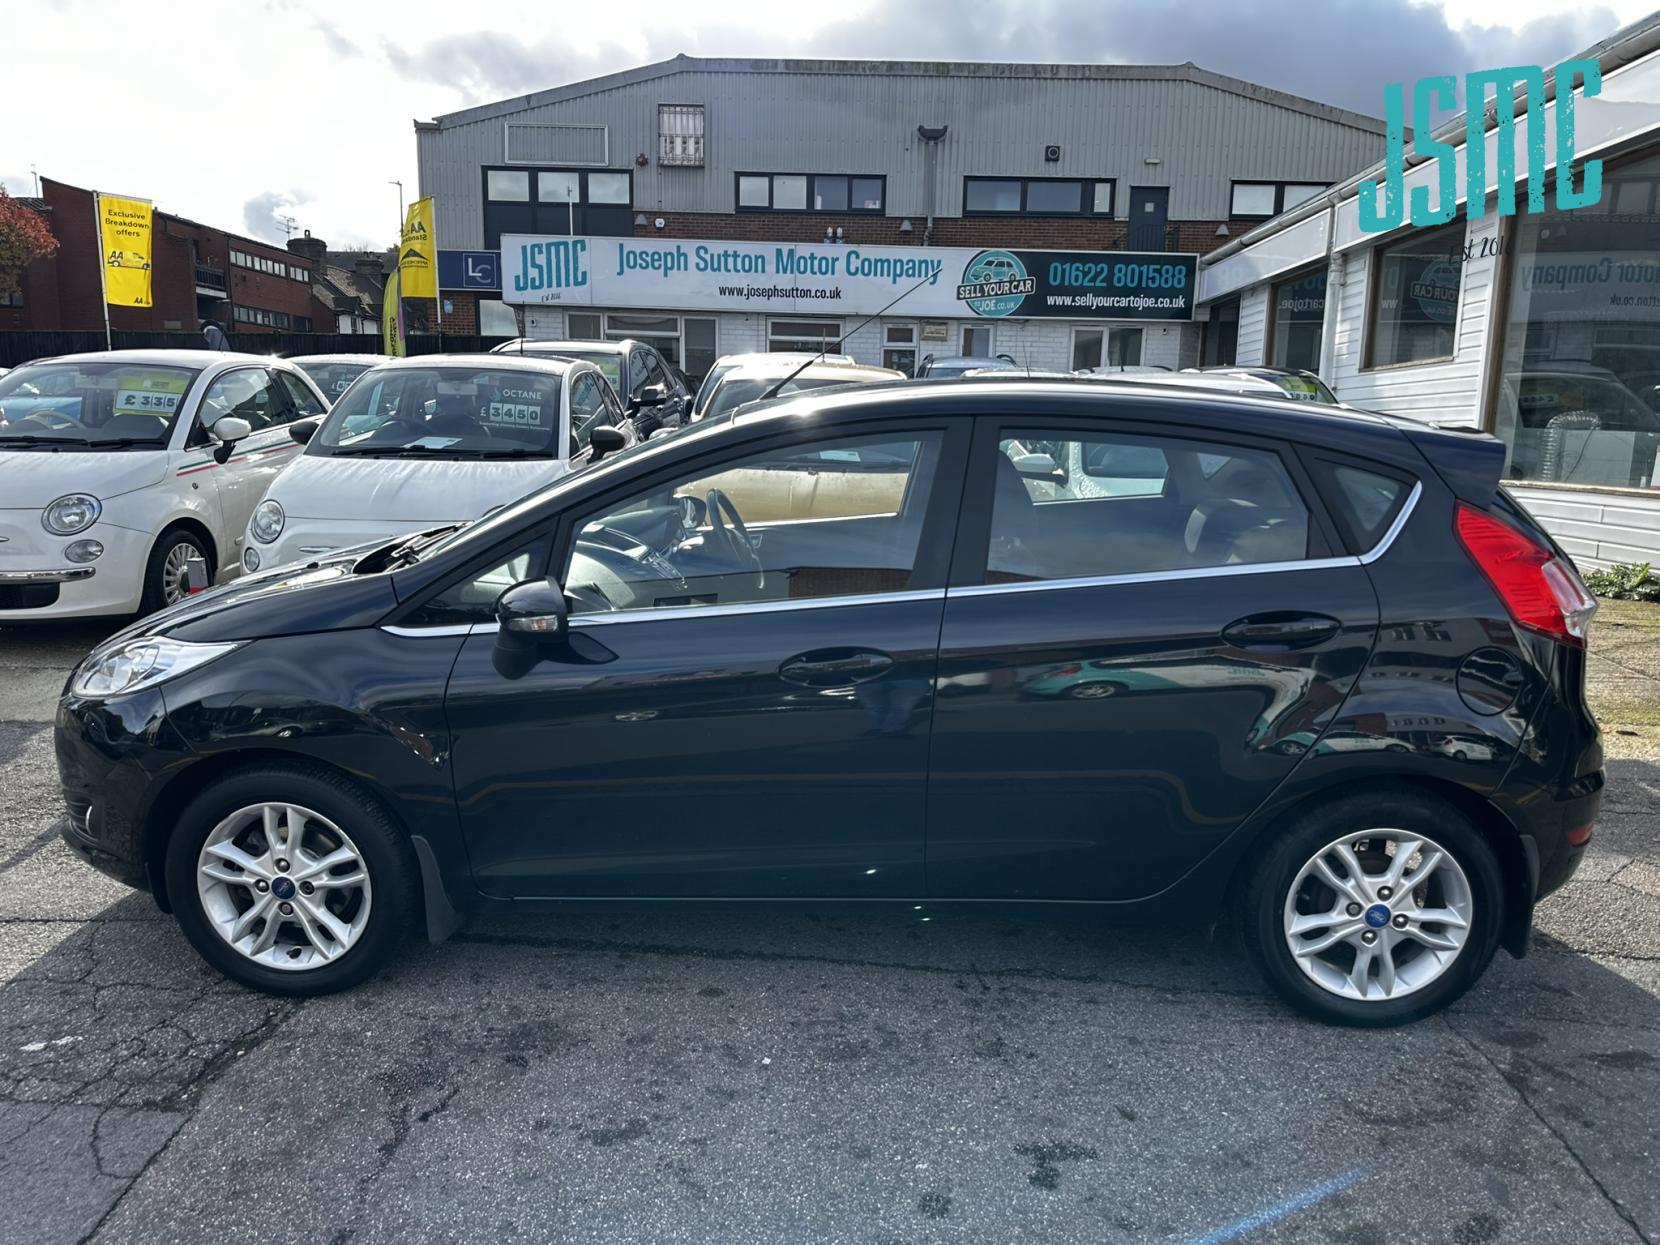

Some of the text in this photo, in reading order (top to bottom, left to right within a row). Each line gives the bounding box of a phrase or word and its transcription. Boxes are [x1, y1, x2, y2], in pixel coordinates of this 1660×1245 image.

[107, 208, 146, 220] Exclusive
[105, 217, 150, 230] Breakdown
[115, 229, 141, 238] offers
[109, 250, 124, 260] AA
[513, 238, 588, 292] JSMC
[616, 242, 942, 286] Joseph Sutton Motor Company
[1049, 262, 1108, 288] 01622
[1113, 263, 1187, 289] 801588
[718, 284, 843, 301] www.josephsutton.co.uk
[959, 280, 1033, 299] SELL YOUR CAR
[1046, 293, 1186, 311] www.sellyourcartojoe.co.uk
[502, 388, 543, 400] OCTANE
